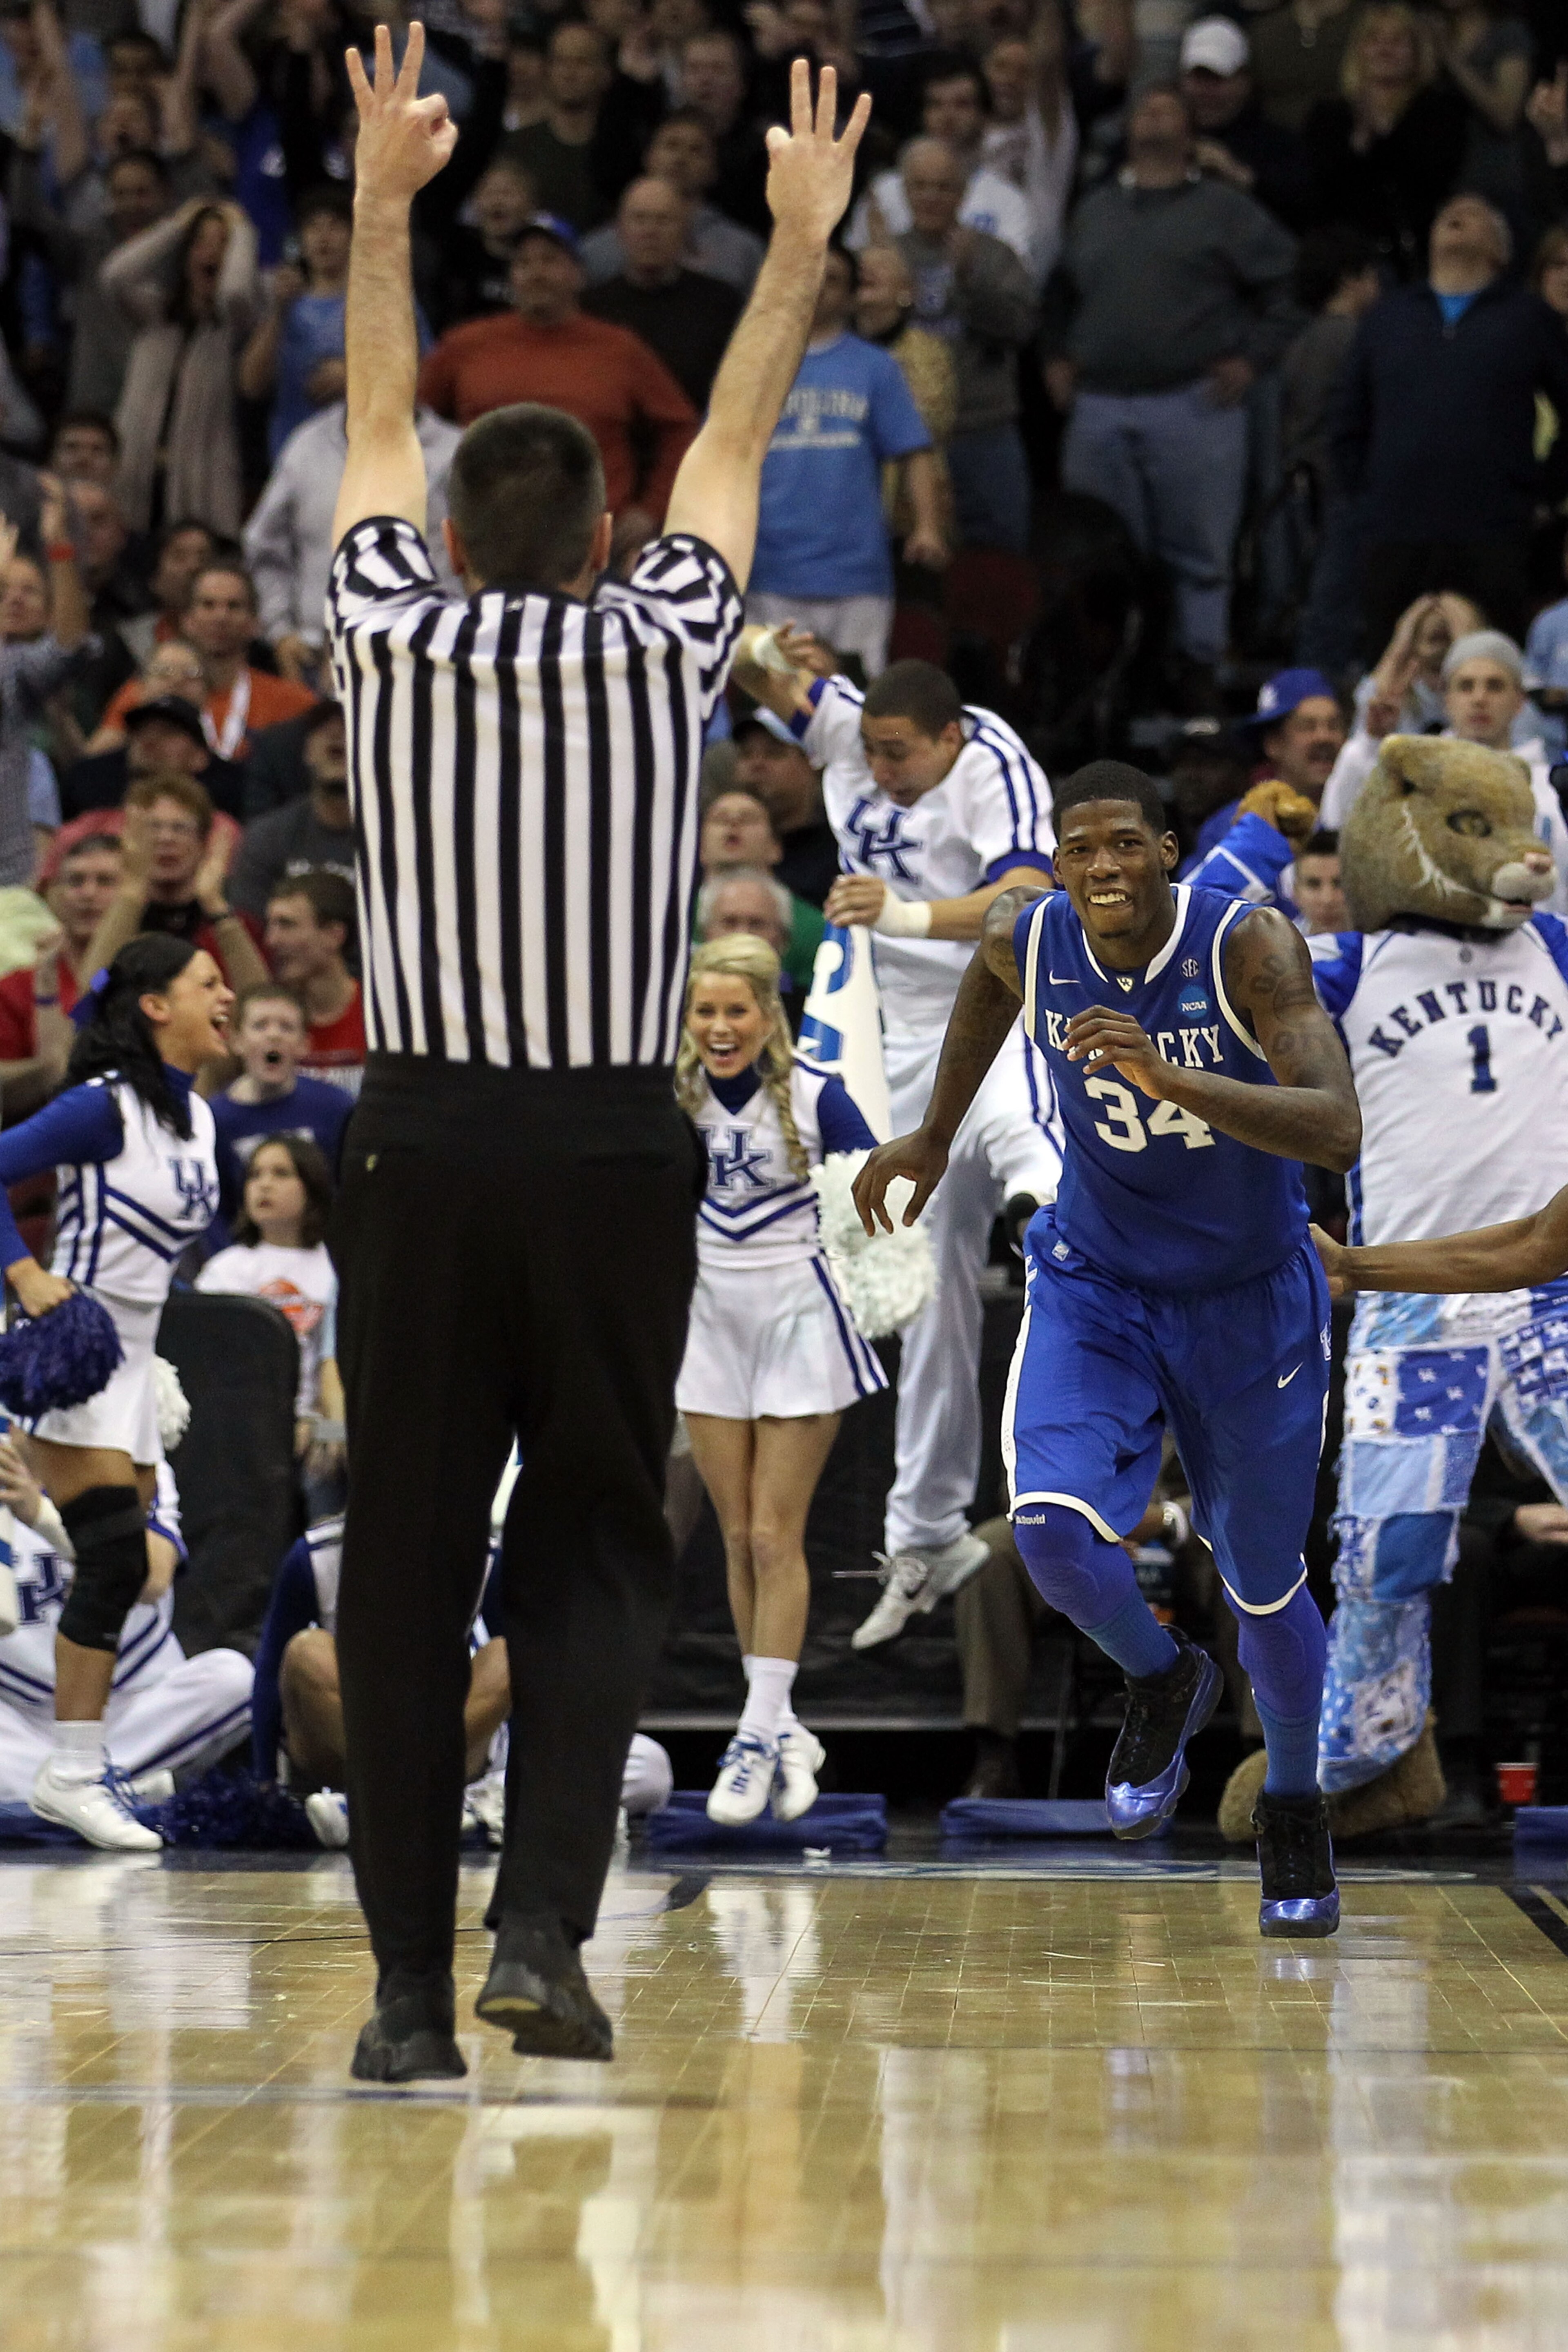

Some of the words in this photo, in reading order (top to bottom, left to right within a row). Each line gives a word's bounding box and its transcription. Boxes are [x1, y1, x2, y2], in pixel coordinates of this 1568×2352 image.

[1181, 958, 1199, 977] SEC
[1181, 1001, 1207, 1012] NCAA
[1368, 980, 1563, 1058] KENTUCKY
[1045, 1009, 1224, 1068] KCKY
[1468, 1024, 1497, 1092] 1
[1083, 1076, 1216, 1153] 34
